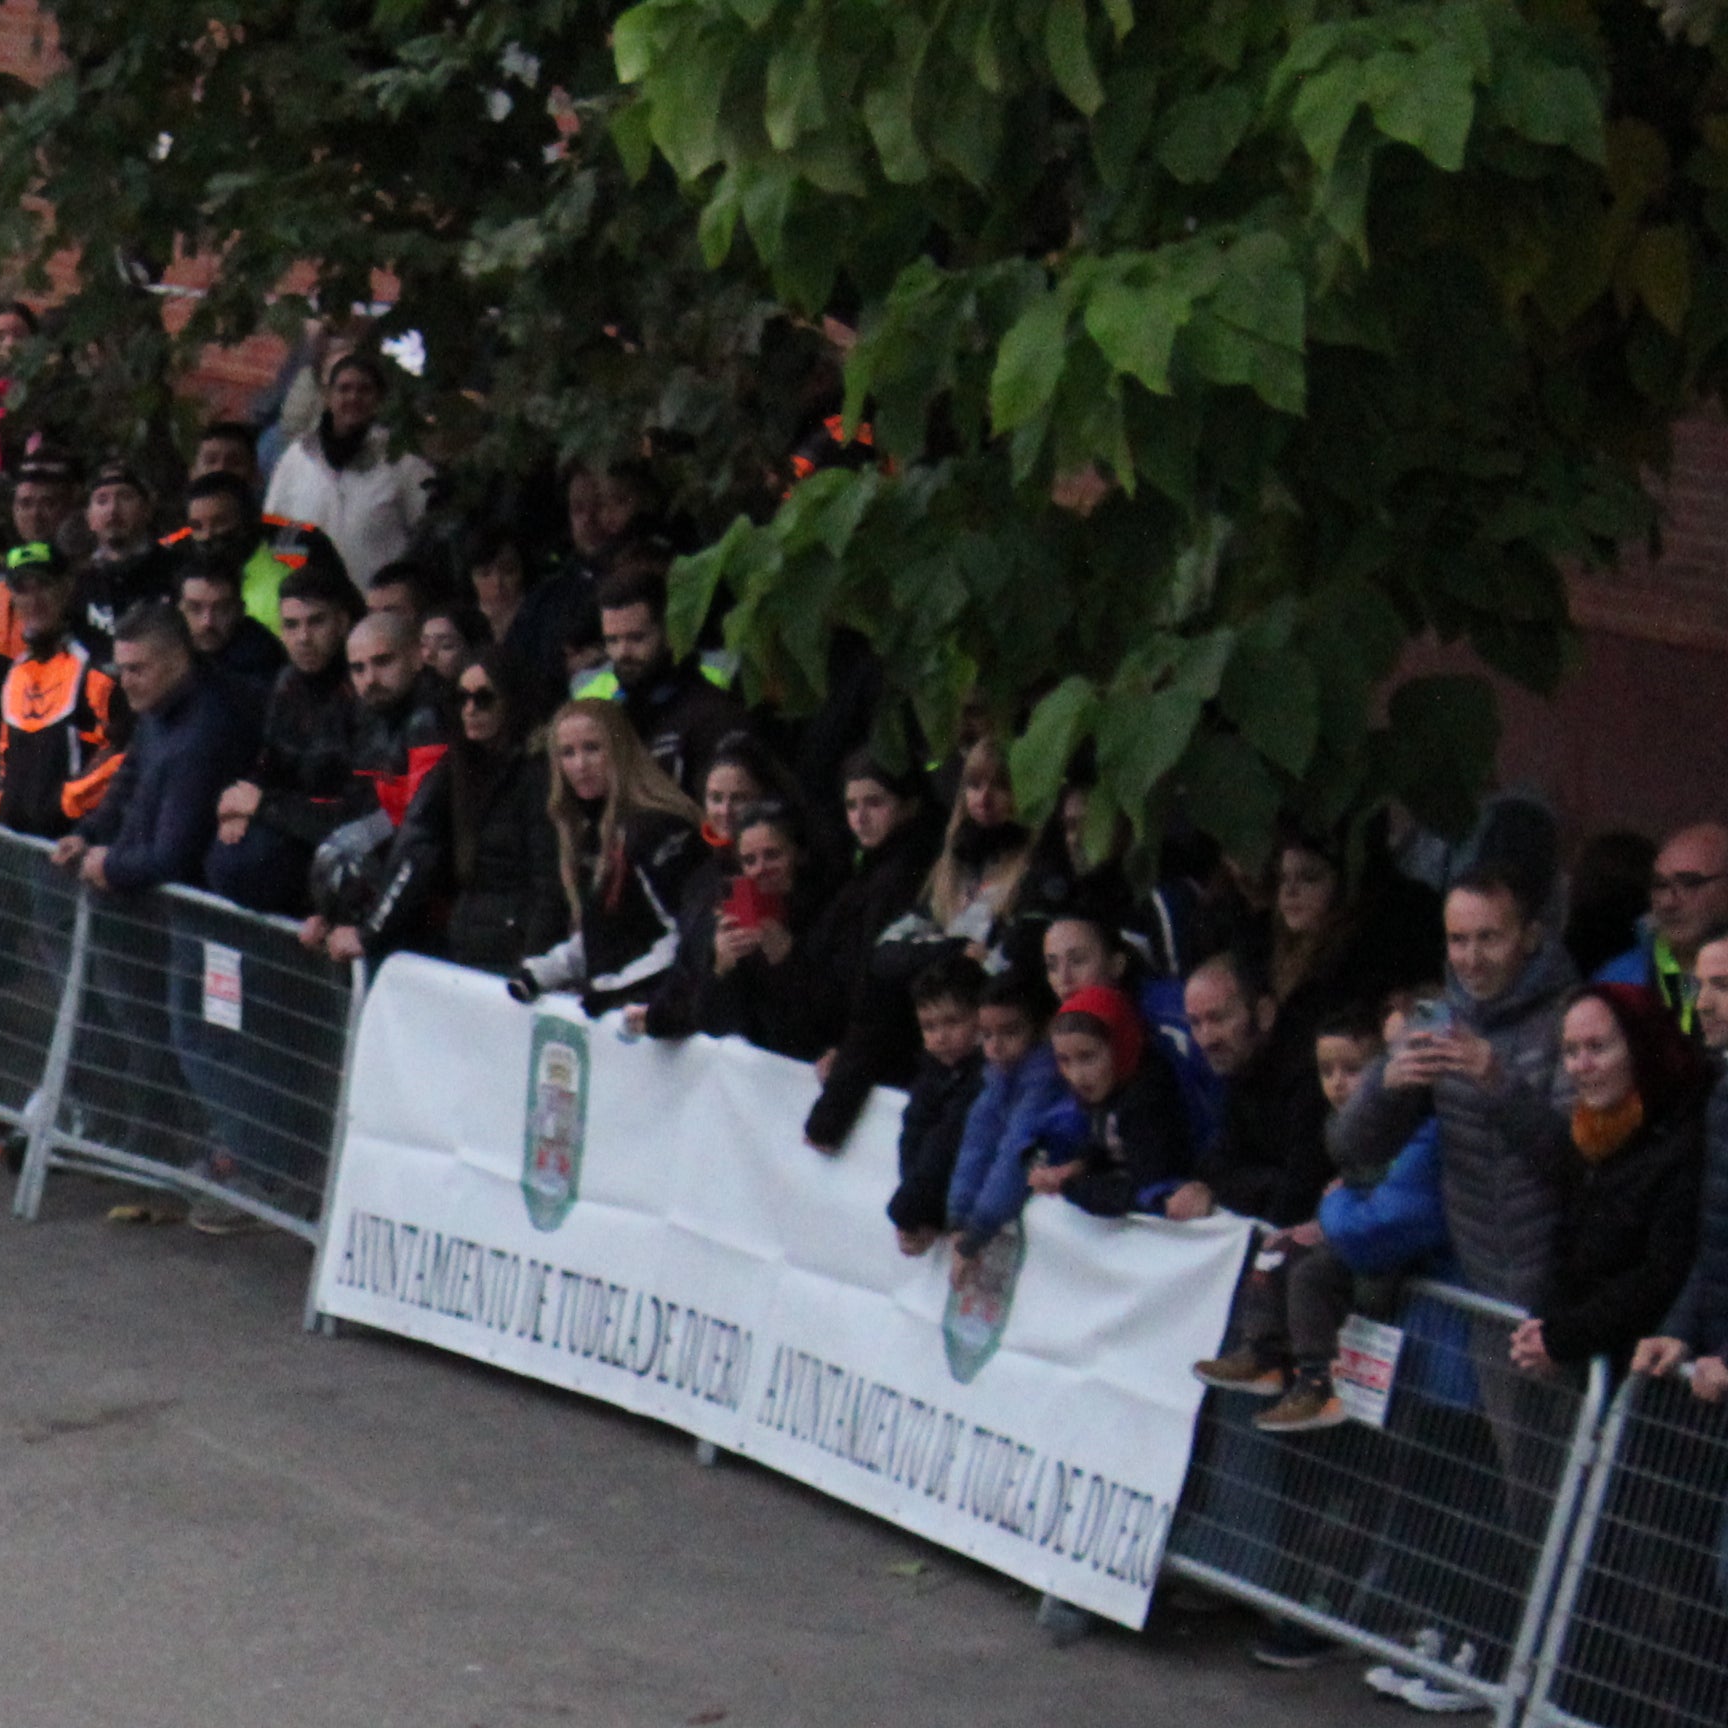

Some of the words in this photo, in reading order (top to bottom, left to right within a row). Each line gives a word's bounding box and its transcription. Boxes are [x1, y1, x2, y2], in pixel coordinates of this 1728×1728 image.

[337, 1207, 520, 1335] AYUNTAMIENTO
[517, 1258, 552, 1342] DE
[553, 1268, 644, 1368] TUDELA
[675, 1307, 754, 1413] DUERO
[757, 1345, 936, 1490] AYUNTAMIENTO
[957, 1424, 1049, 1542] TUDELA
[1039, 1460, 1084, 1555] DE
